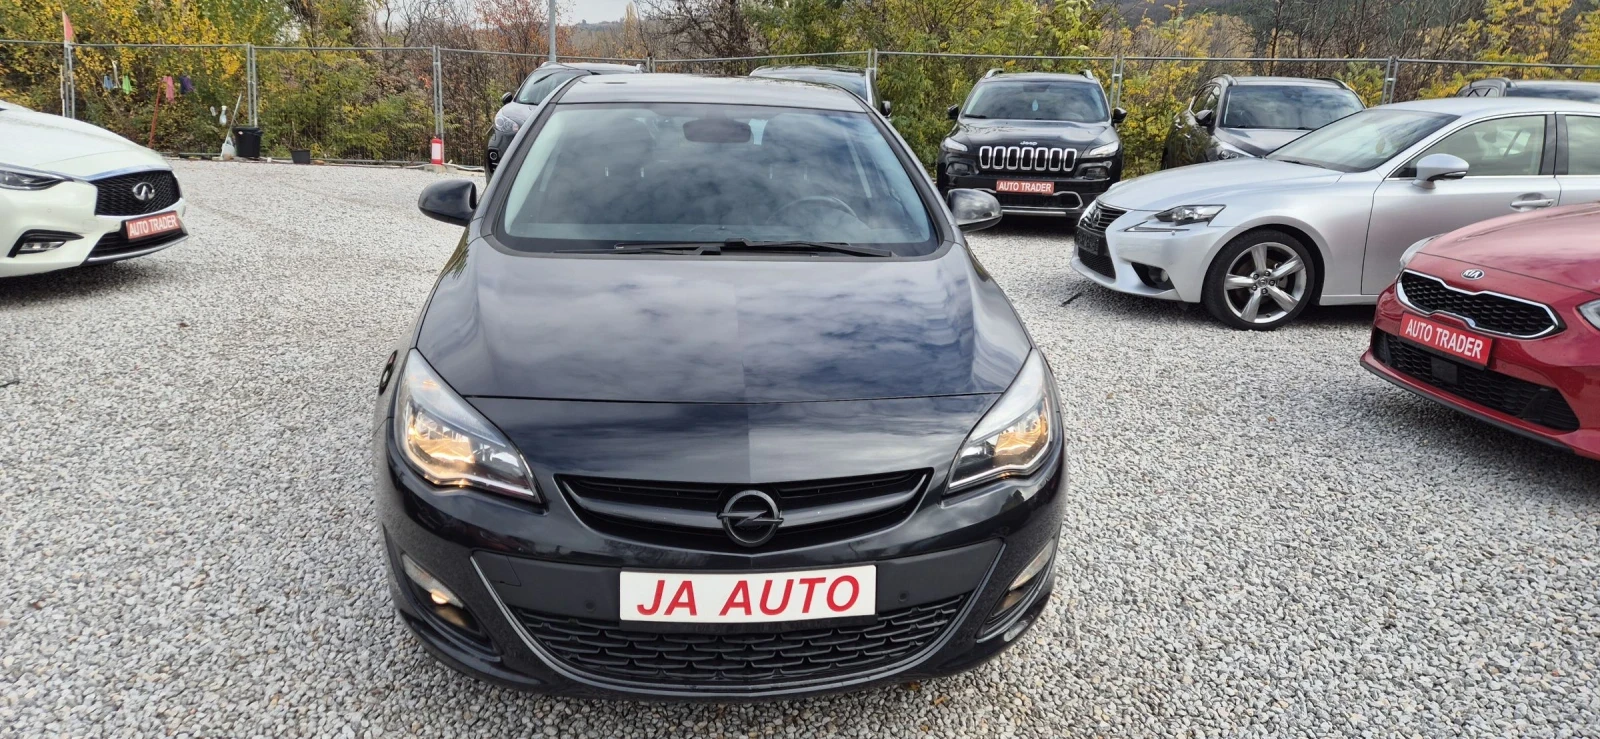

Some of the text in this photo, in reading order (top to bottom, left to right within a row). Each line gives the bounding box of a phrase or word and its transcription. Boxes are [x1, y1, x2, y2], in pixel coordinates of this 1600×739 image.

[999, 182, 1052, 192] AUTO TRADER
[129, 214, 179, 237] AUTO TRADER
[1461, 269, 1482, 279] KIA
[1405, 318, 1484, 359] AUTO TRADER
[636, 575, 860, 616] JA AUTO
